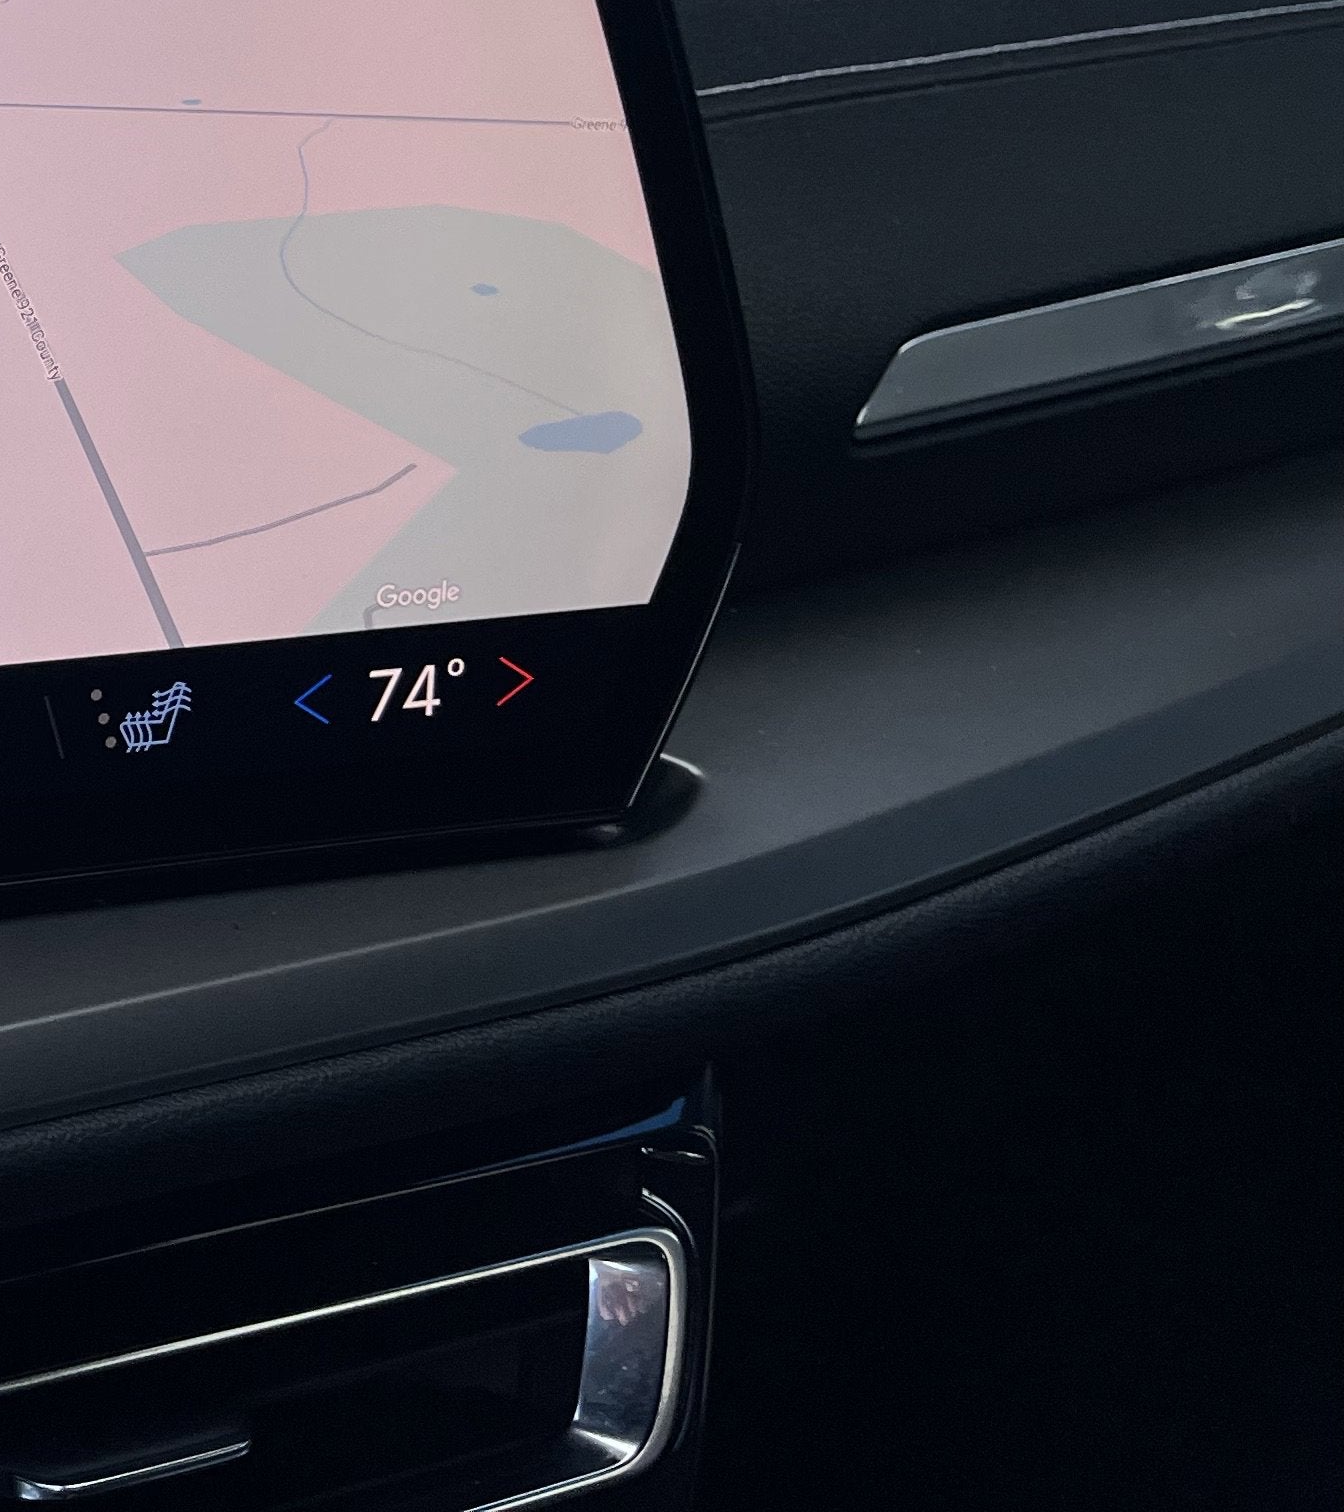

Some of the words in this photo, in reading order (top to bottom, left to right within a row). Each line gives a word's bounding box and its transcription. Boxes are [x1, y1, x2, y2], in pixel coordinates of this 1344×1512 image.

[572, 116, 617, 131] Greene
[16, 297, 39, 328] 921
[31, 329, 61, 381] County
[376, 579, 461, 610] Google
[368, 657, 466, 722] 74°
